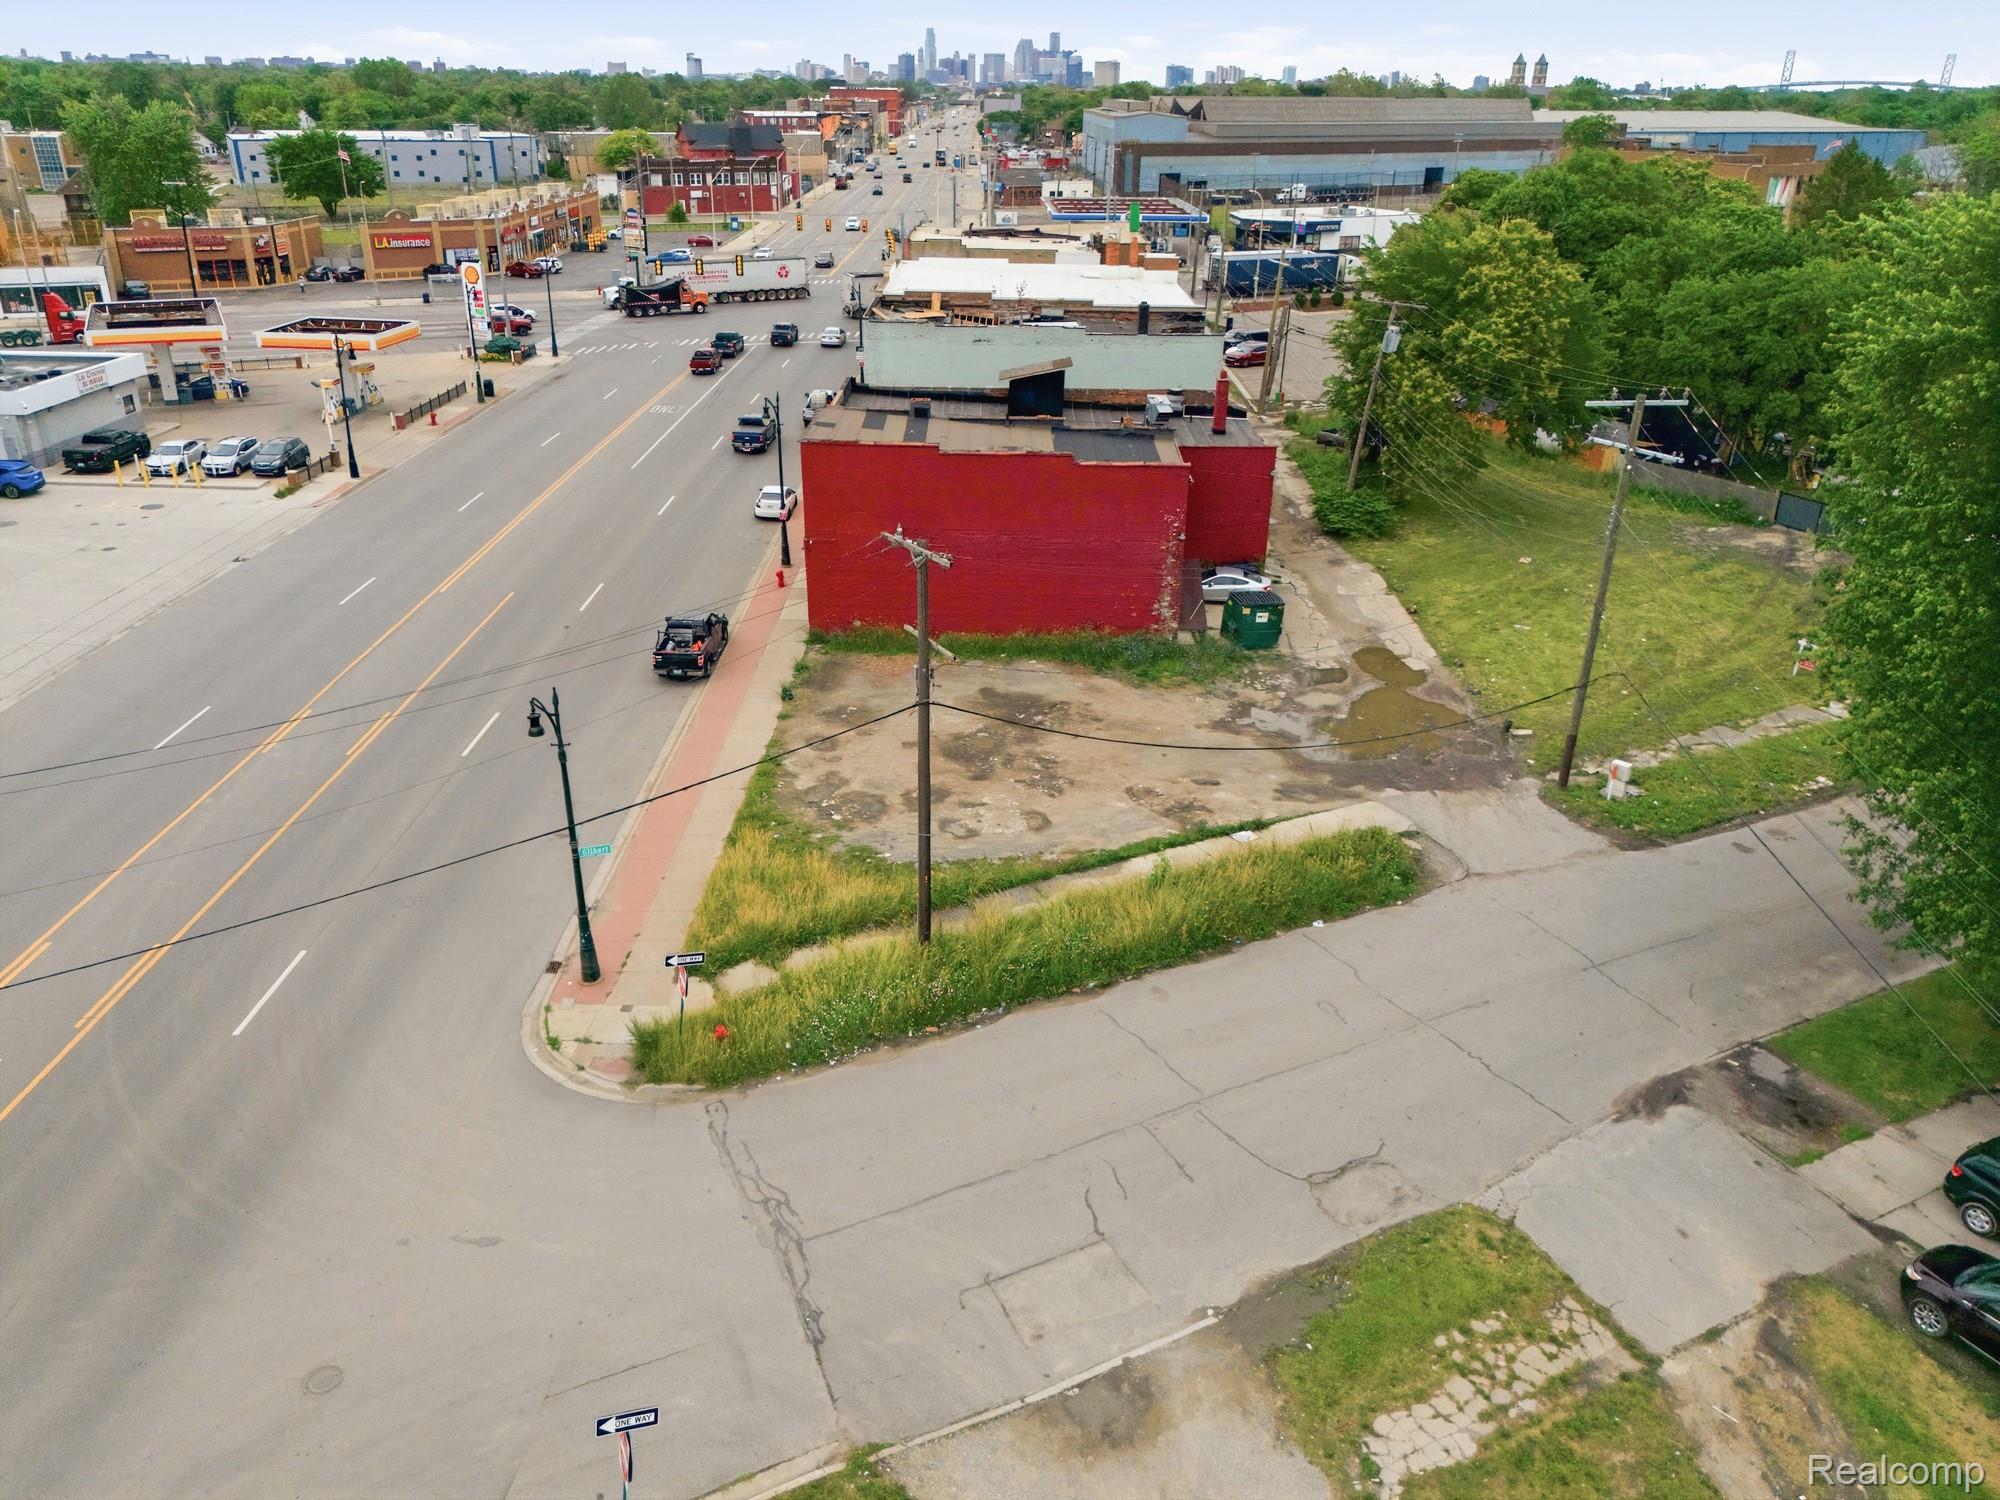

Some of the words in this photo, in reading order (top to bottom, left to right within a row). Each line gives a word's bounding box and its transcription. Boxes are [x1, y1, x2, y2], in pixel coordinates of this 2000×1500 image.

[390, 238, 431, 248] insurance
[614, 1418, 631, 1427] ONE
[635, 1414, 652, 1423] WAY
